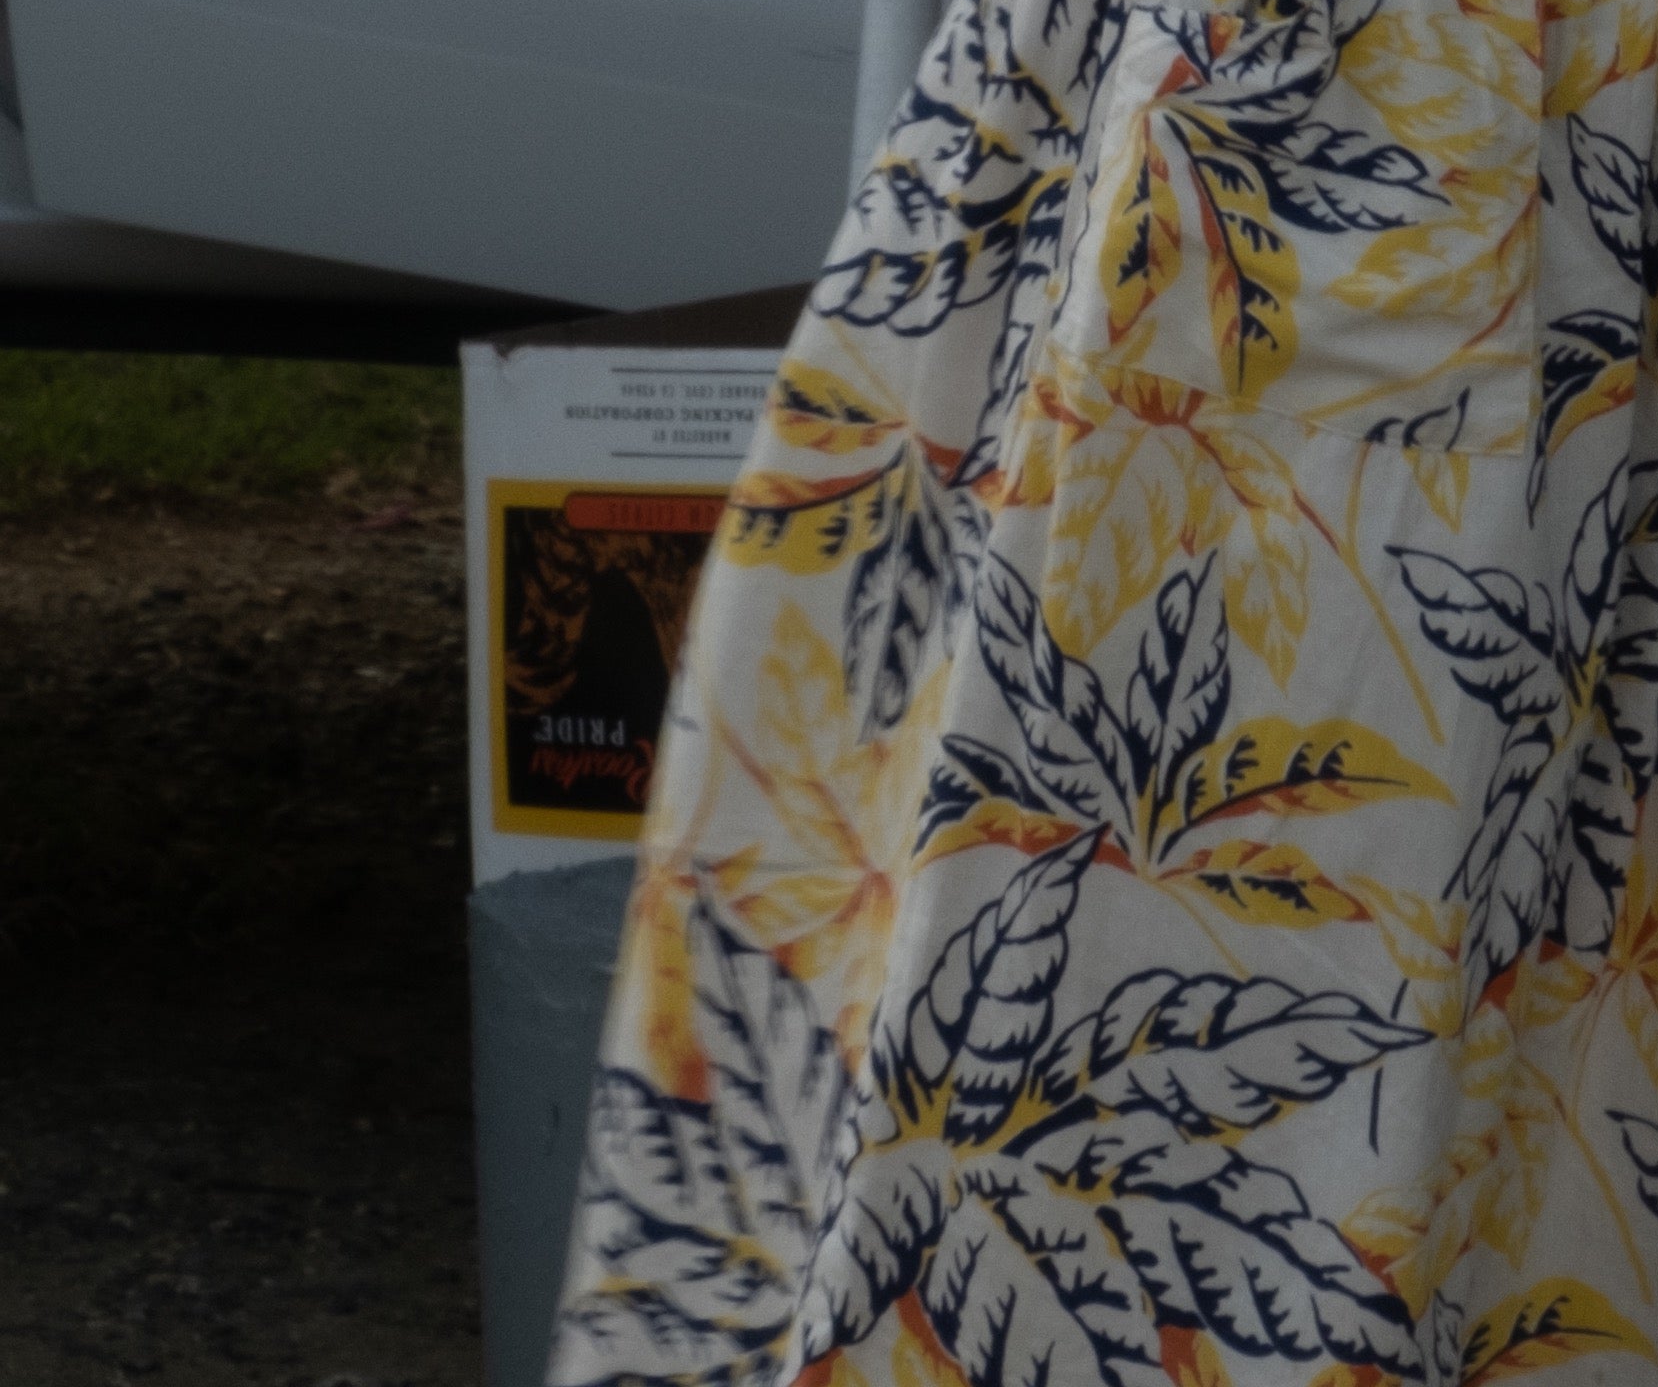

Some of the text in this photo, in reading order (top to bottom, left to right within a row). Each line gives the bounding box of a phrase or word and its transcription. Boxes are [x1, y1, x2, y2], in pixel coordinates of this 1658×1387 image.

[564, 405, 755, 423] PACKING CORPORATION
[538, 715, 626, 747] PRIDE
